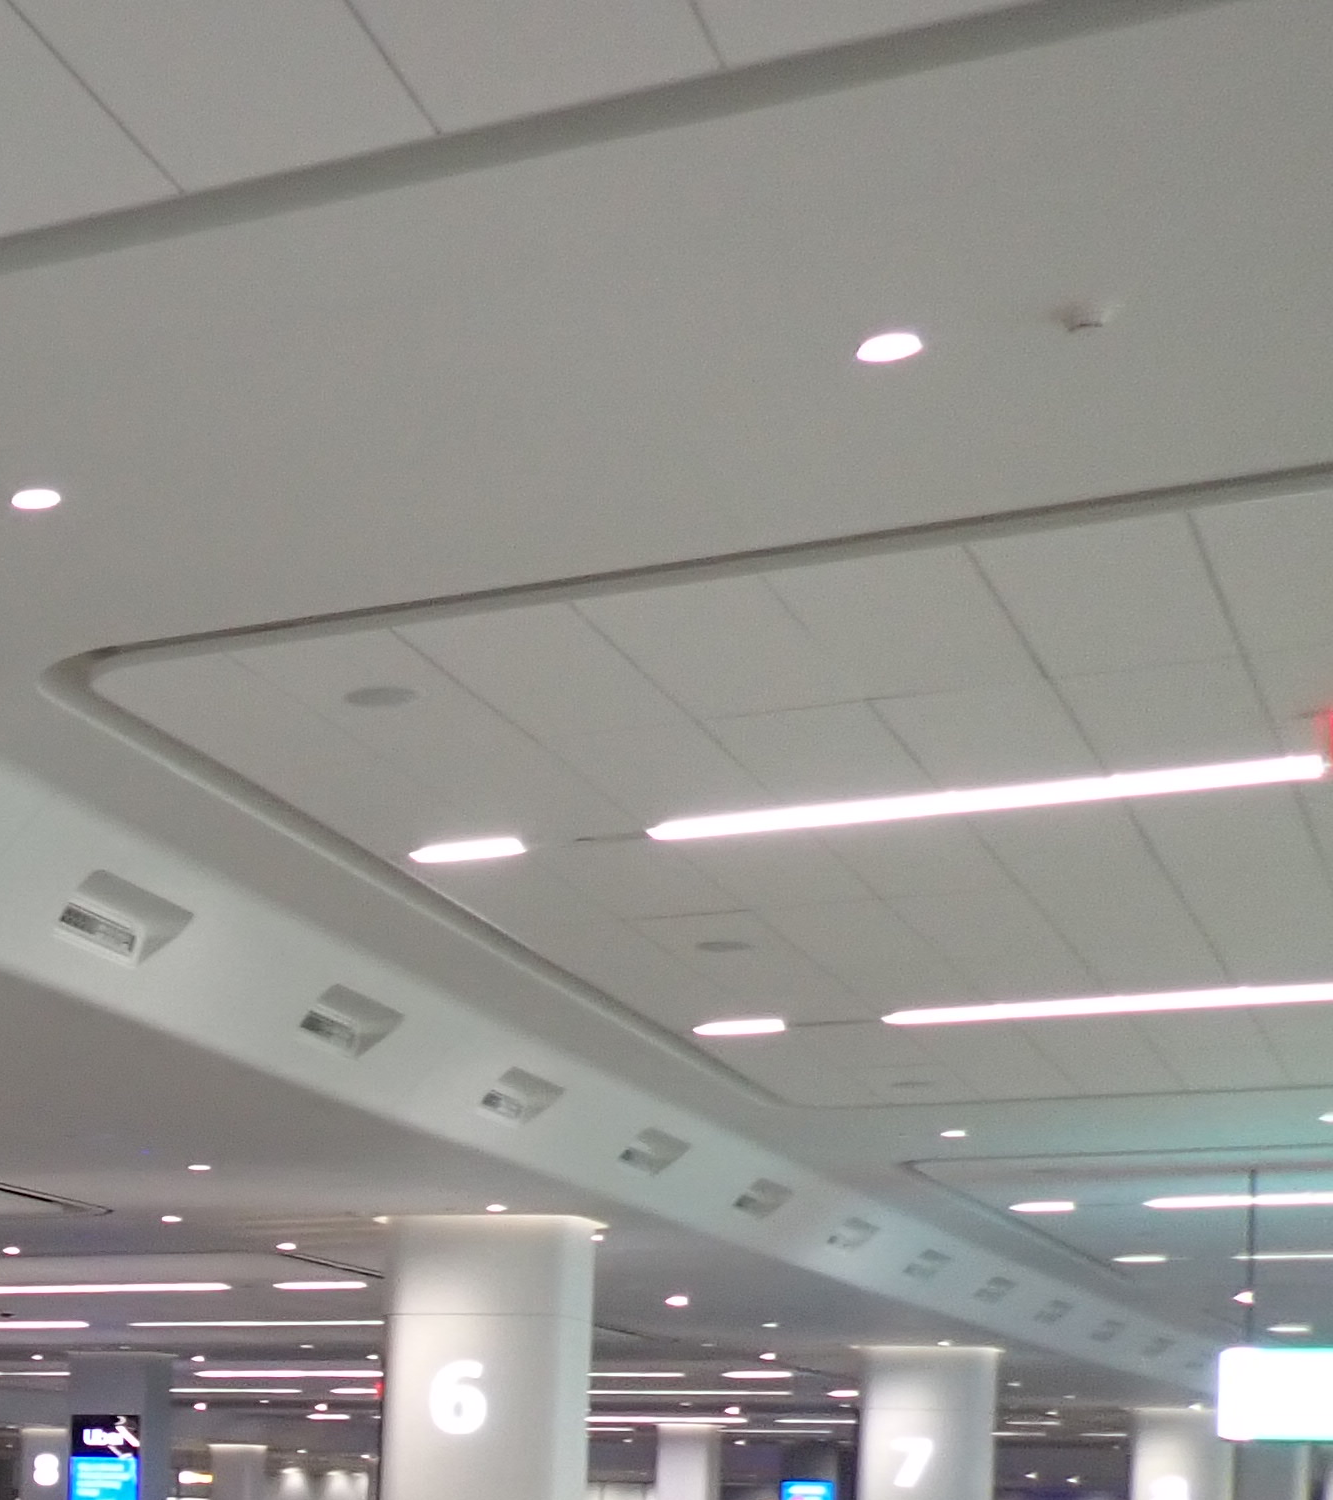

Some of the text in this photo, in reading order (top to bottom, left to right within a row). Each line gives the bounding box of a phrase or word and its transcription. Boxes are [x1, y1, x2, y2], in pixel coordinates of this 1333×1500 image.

[429, 1359, 488, 1435] 6
[32, 1453, 60, 1487] 8
[888, 1435, 935, 1488] 7
